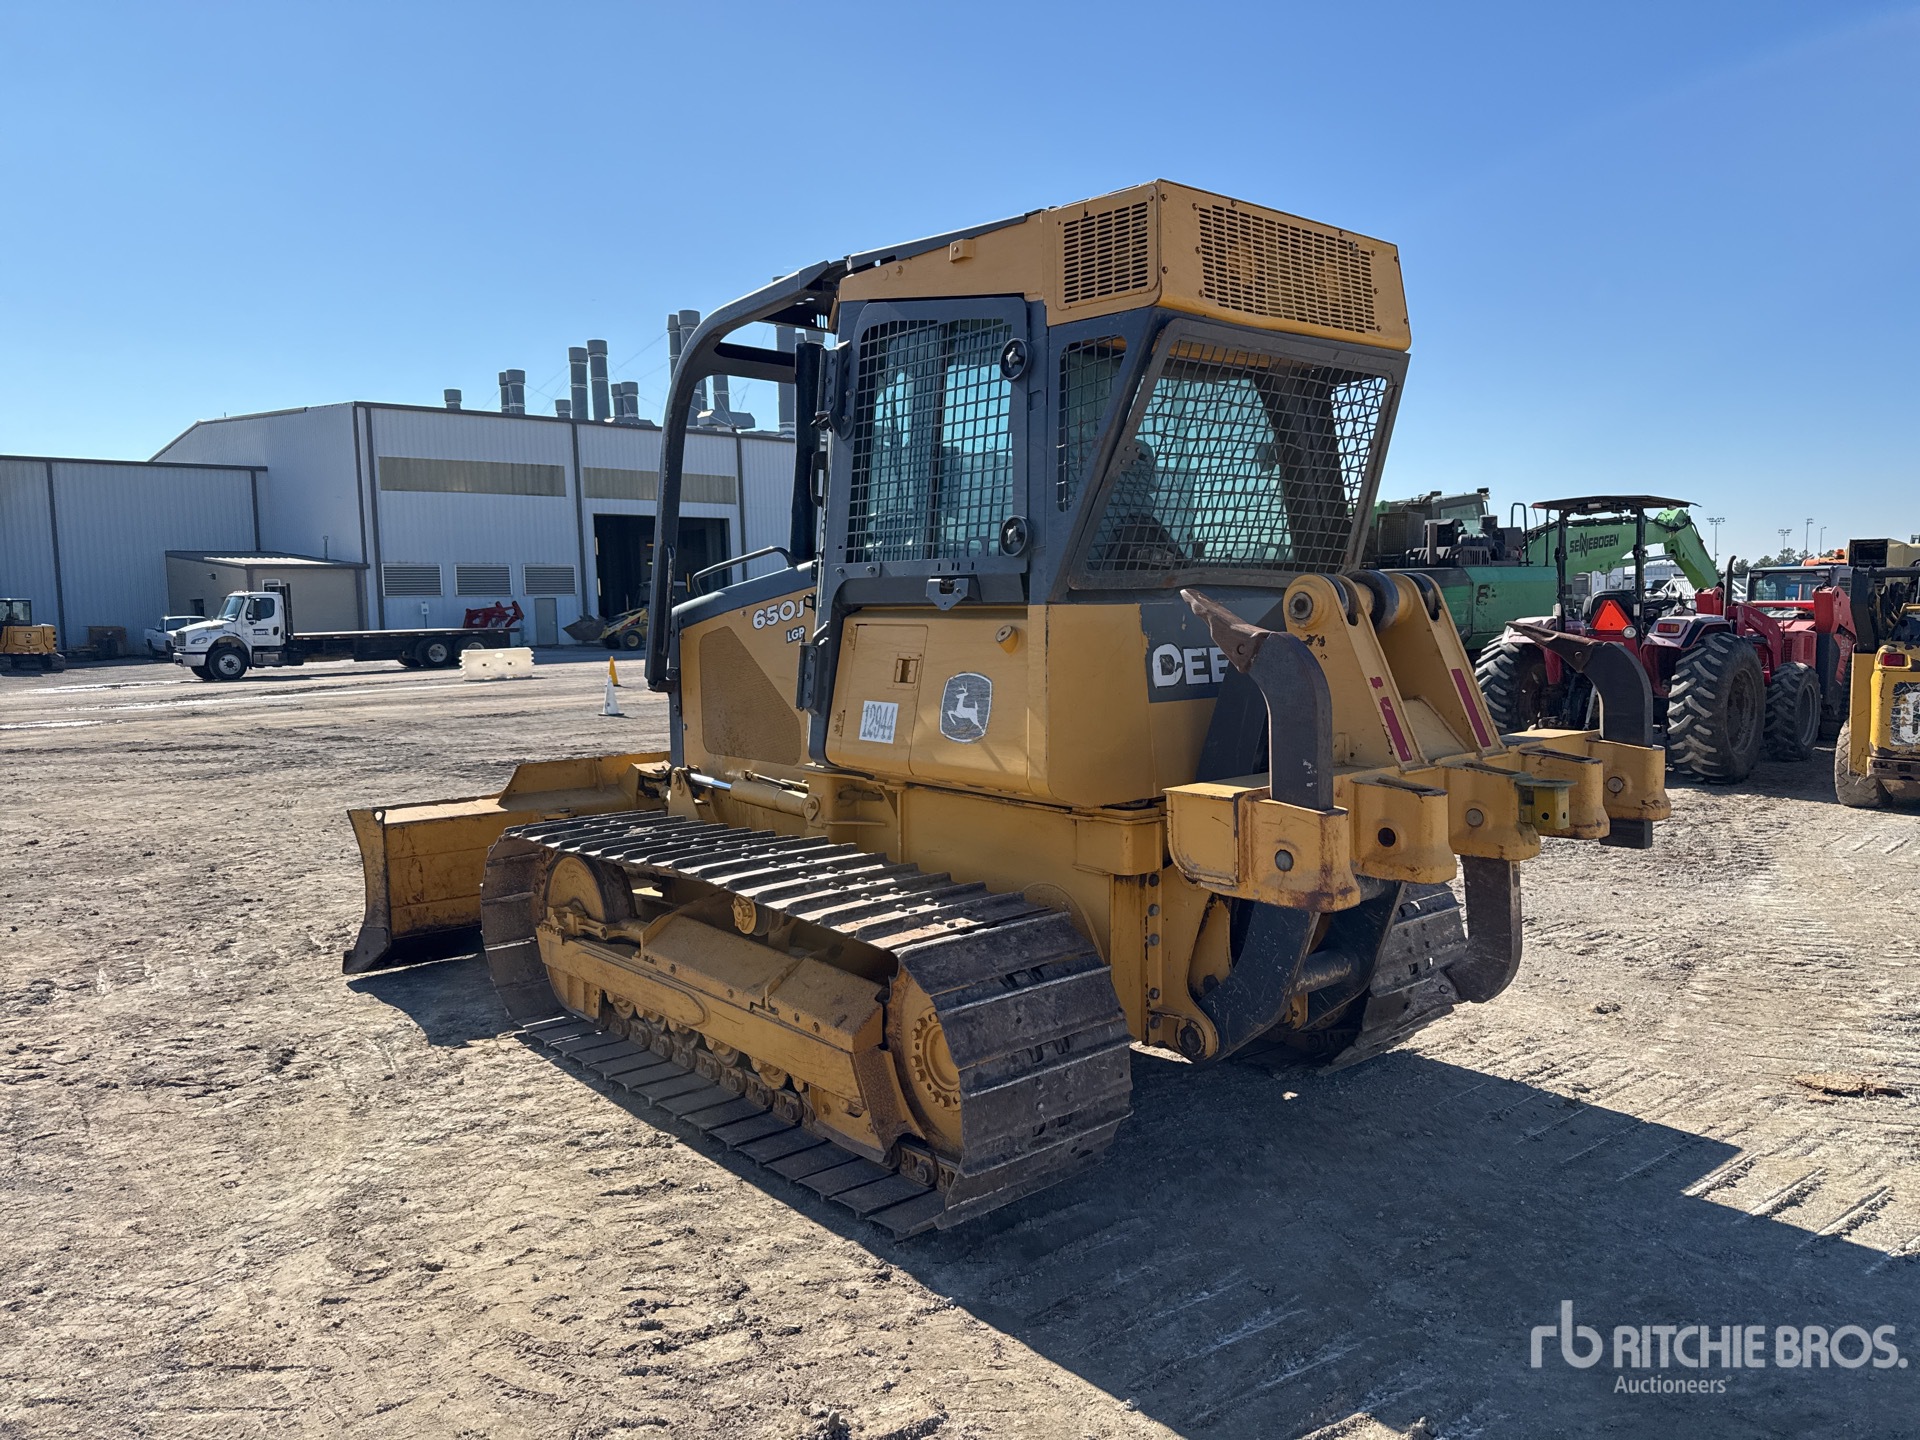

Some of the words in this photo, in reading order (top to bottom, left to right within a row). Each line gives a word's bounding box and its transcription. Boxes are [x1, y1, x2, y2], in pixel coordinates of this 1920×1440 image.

[1569, 532, 1619, 558] SENNEBOGEN
[752, 599, 804, 630] 650J
[787, 626, 805, 642] LGP
[861, 703, 895, 741] 12944
